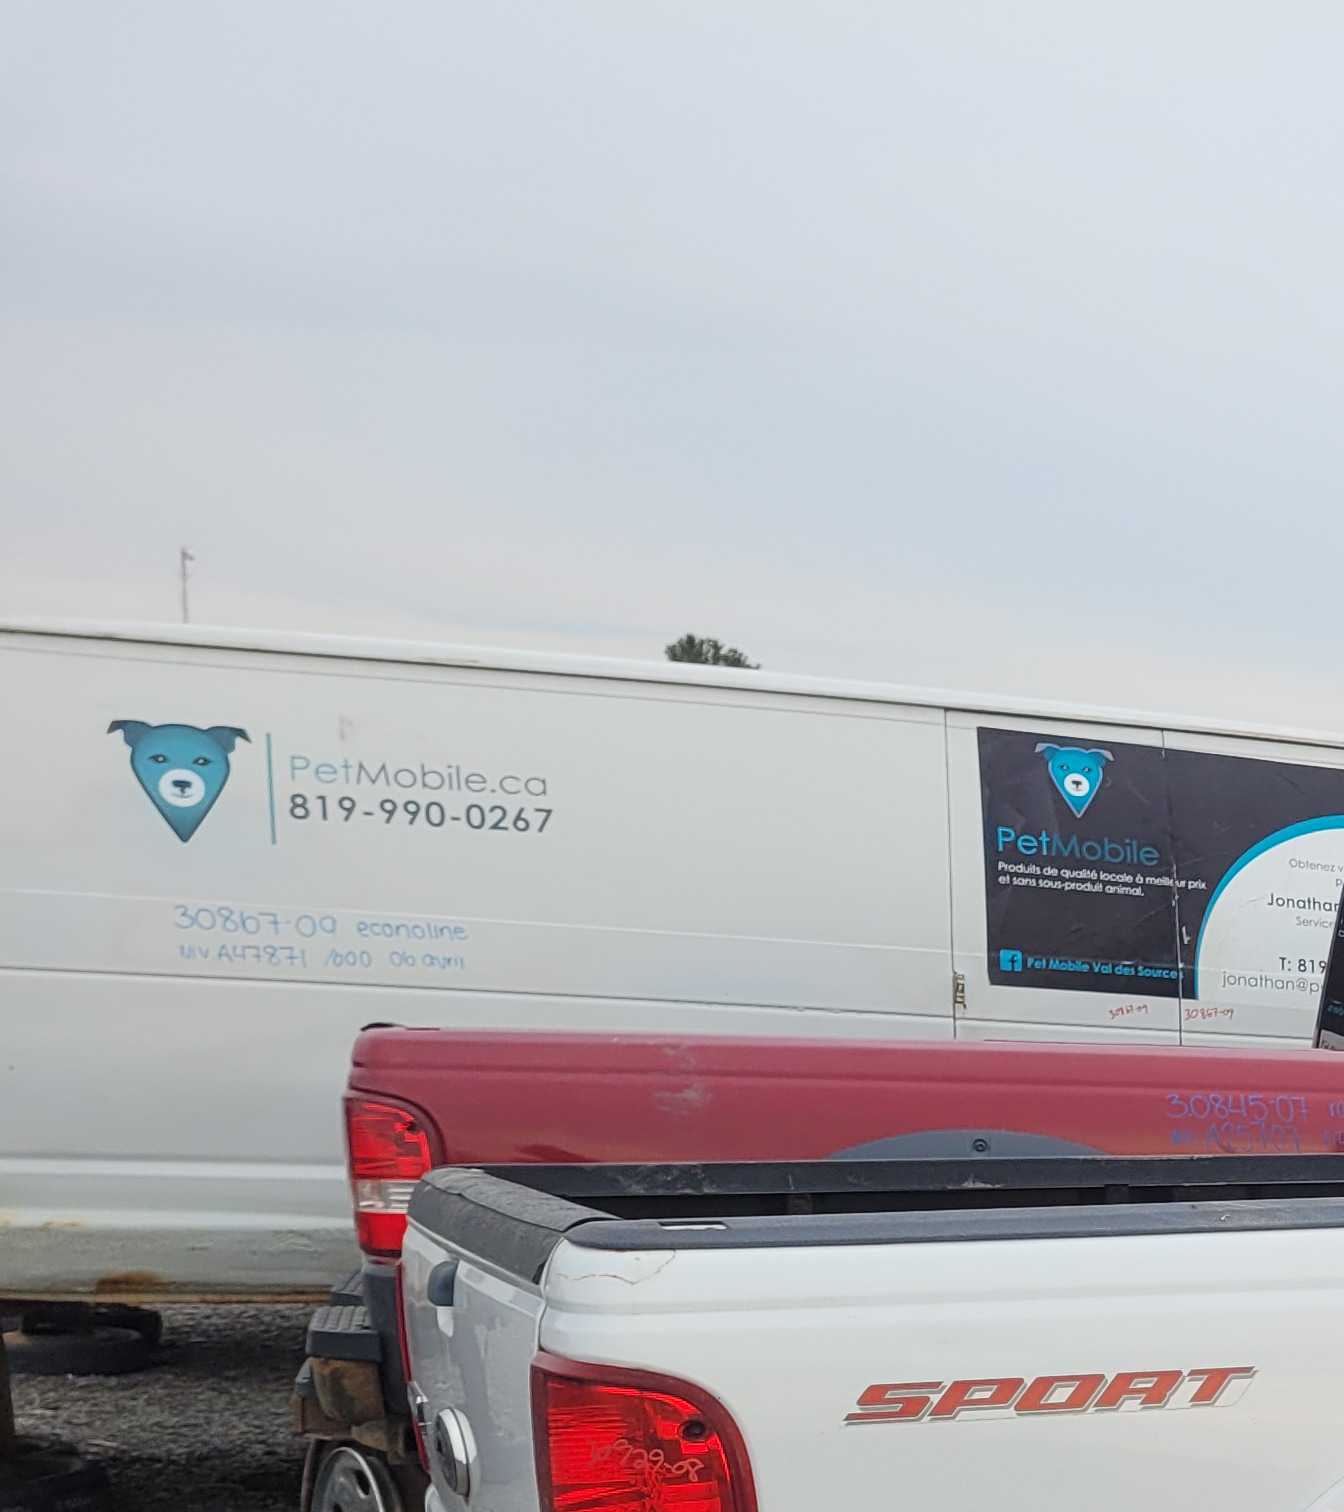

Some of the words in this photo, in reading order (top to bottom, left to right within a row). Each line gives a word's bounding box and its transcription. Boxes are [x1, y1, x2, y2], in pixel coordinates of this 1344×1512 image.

[289, 754, 549, 798] PetMobile.ca
[289, 793, 554, 833] 819-990-0267
[996, 825, 1161, 867] PetMobile
[997, 861, 1041, 876] Produits
[1043, 865, 1059, 876] de
[1060, 867, 1098, 883] qualité
[1100, 870, 1133, 885] locale
[998, 874, 1010, 885] et
[1012, 876, 1037, 888] sans
[1038, 878, 1103, 894] sous-produit
[357, 920, 470, 942] econoline
[422, 951, 465, 970] avril
[1048, 958, 1090, 974] Mobile
[1092, 961, 1113, 976] Val
[1114, 963, 1136, 977] des
[1279, 956, 1292, 972] T:
[1298, 958, 1328, 974] 819
[842, 1366, 1259, 1425] SPORT
